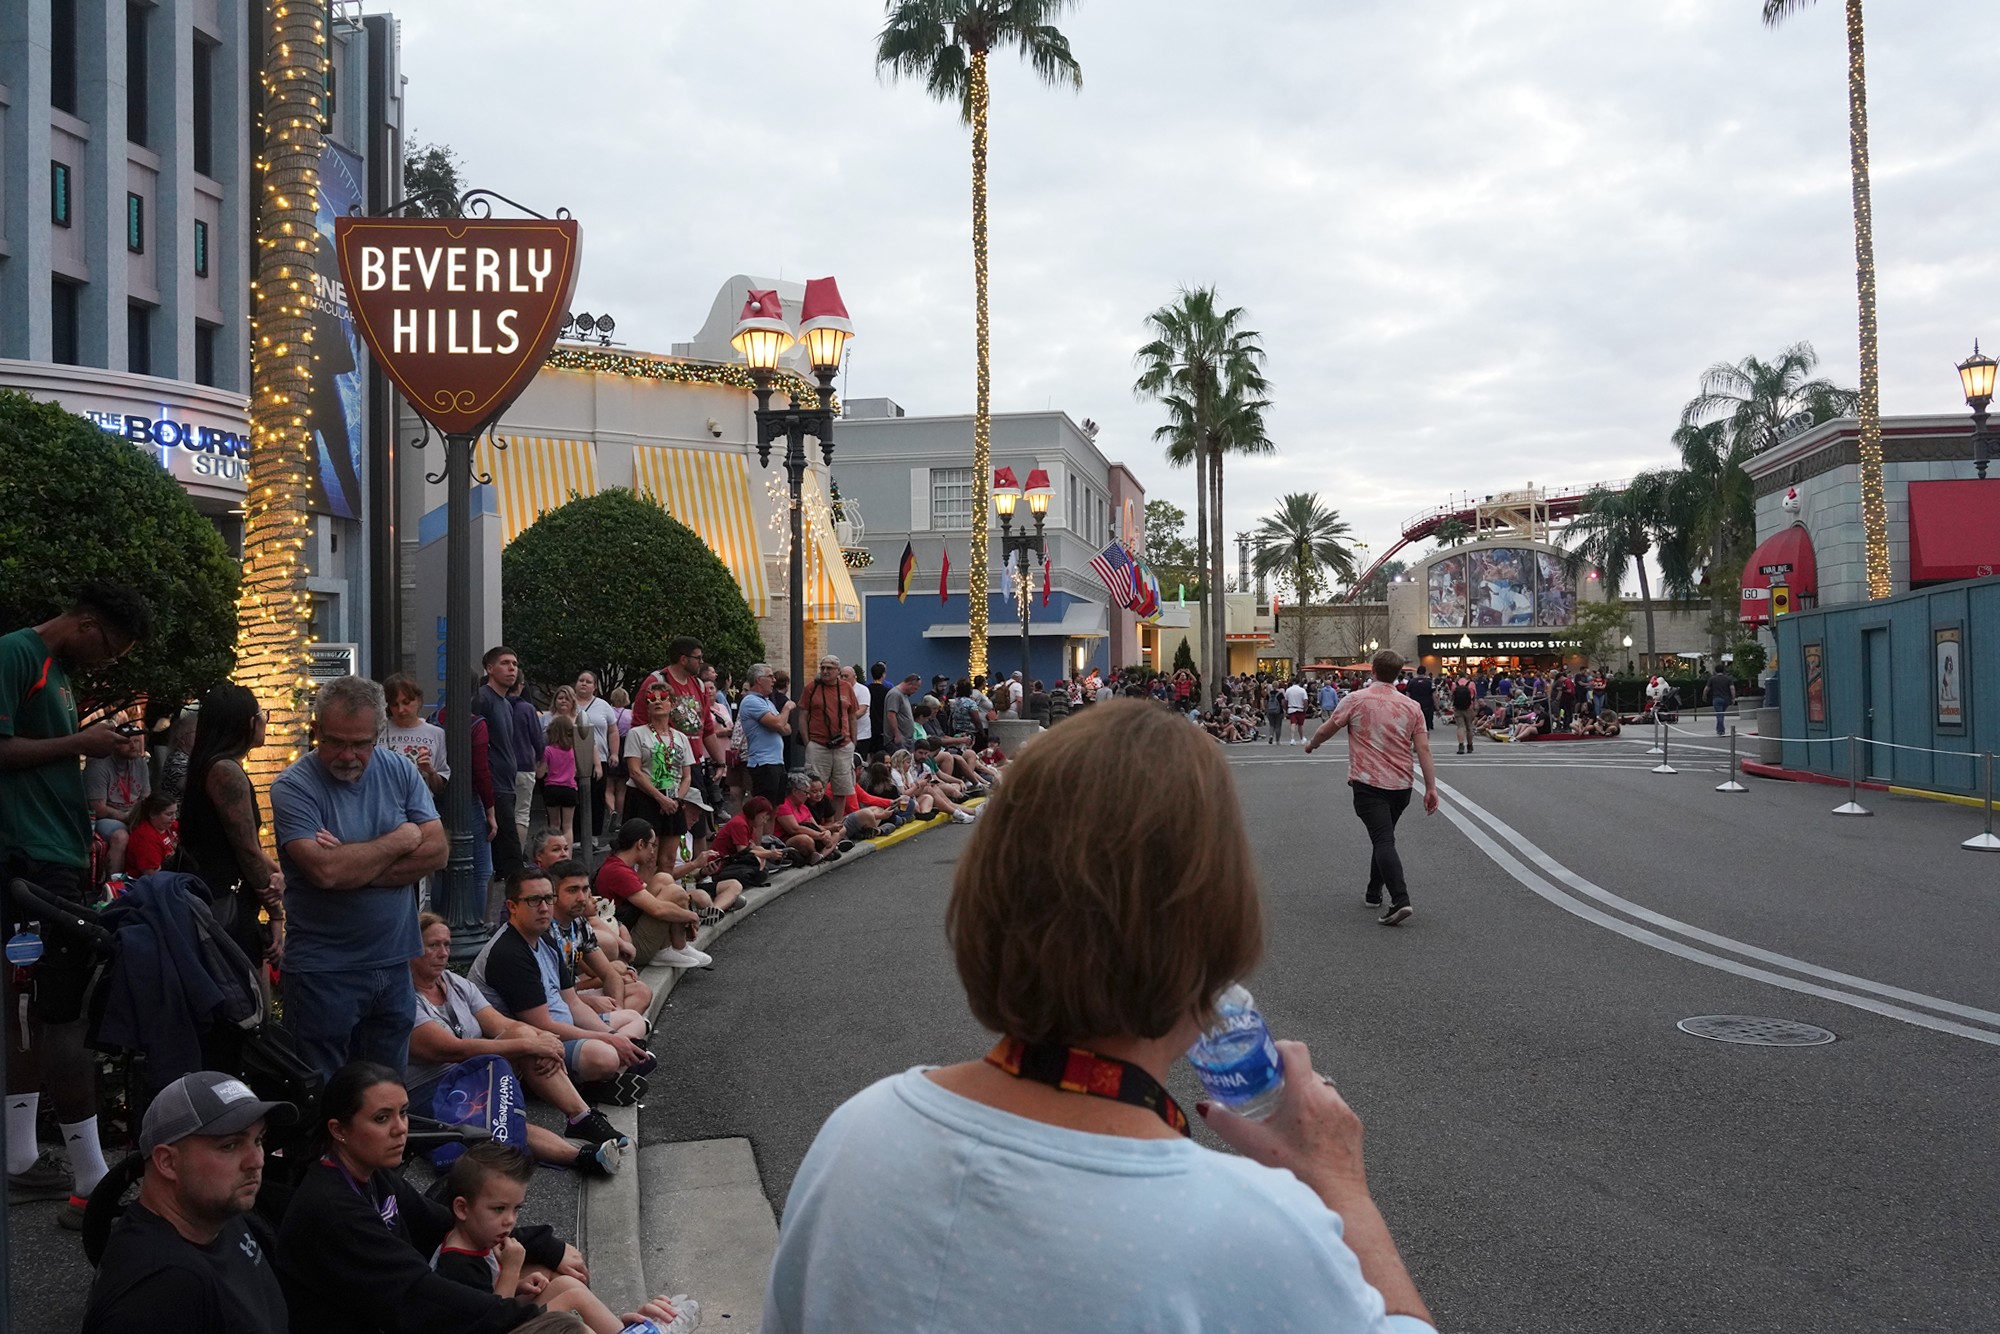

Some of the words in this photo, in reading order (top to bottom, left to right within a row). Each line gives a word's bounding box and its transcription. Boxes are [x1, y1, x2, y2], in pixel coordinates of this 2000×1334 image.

[361, 246, 553, 293] BEVERLY
[314, 272, 349, 307] RNE
[313, 297, 357, 325] TACULAR
[393, 308, 520, 355] HILLS
[86, 410, 122, 426] THE
[123, 414, 250, 460] BOURN
[195, 454, 250, 481] STUN
[1744, 589, 1758, 599] GO
[1497, 640, 1545, 650] STUDIOS
[1201, 1072, 1249, 1088] AFINA
